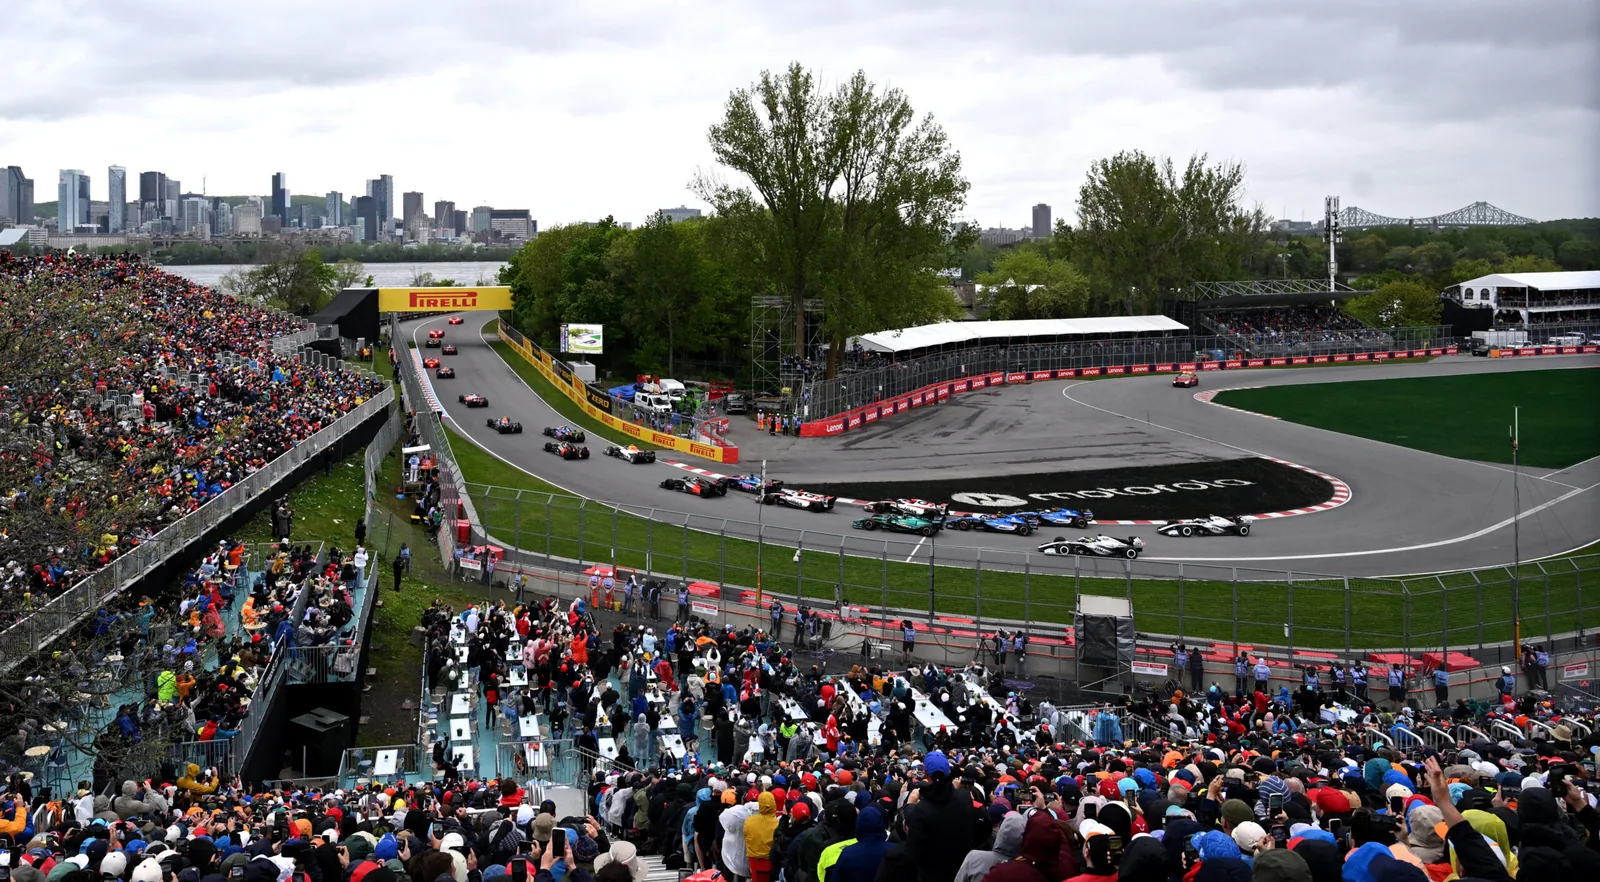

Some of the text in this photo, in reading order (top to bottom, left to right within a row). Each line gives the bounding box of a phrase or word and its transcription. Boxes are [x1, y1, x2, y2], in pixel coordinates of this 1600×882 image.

[410, 292, 477, 307] PIRELLI
[591, 394, 609, 408] ZERO
[826, 423, 843, 432] Lenovo
[653, 434, 675, 447] PIRELLI
[690, 444, 715, 458] PIRELLI
[1028, 478, 1256, 500] motorola
